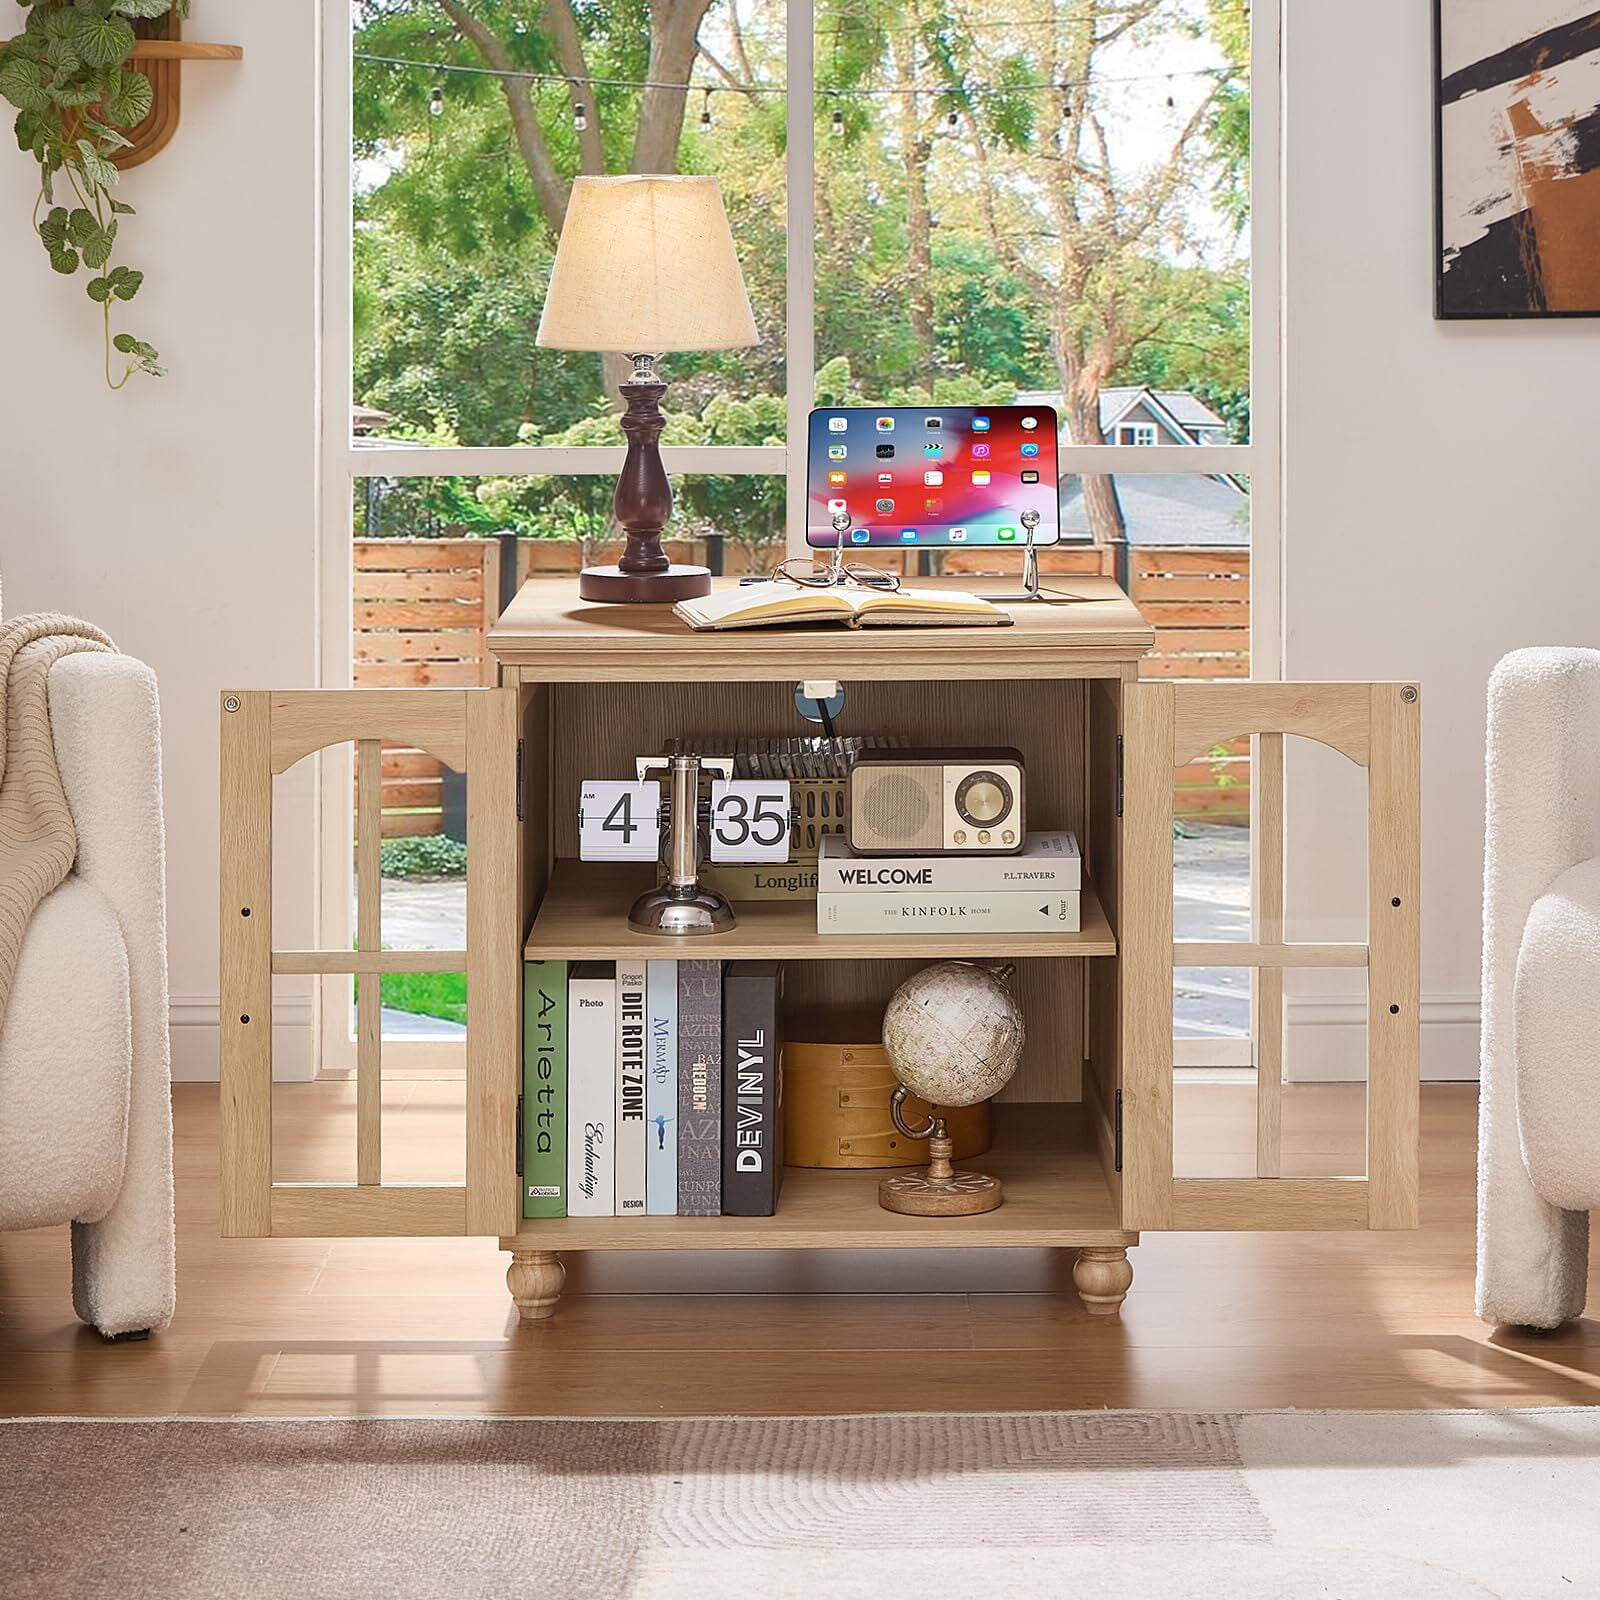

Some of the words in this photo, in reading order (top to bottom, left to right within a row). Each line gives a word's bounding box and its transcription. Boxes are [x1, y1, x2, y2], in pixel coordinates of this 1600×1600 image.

[602, 793, 637, 844] 4
[716, 795, 786, 846] 35
[838, 869, 933, 885] WELCOME
[901, 906, 967, 917] KINFOLK
[579, 998, 604, 1008] Photo
[622, 992, 643, 1021] DIE
[622, 1025, 643, 1071] ROTE
[537, 988, 556, 1154] Arletta
[622, 1074, 643, 1121] ZONE
[736, 1030, 764, 1172] DEVINYL
[622, 1200, 644, 1209] DESIGN
